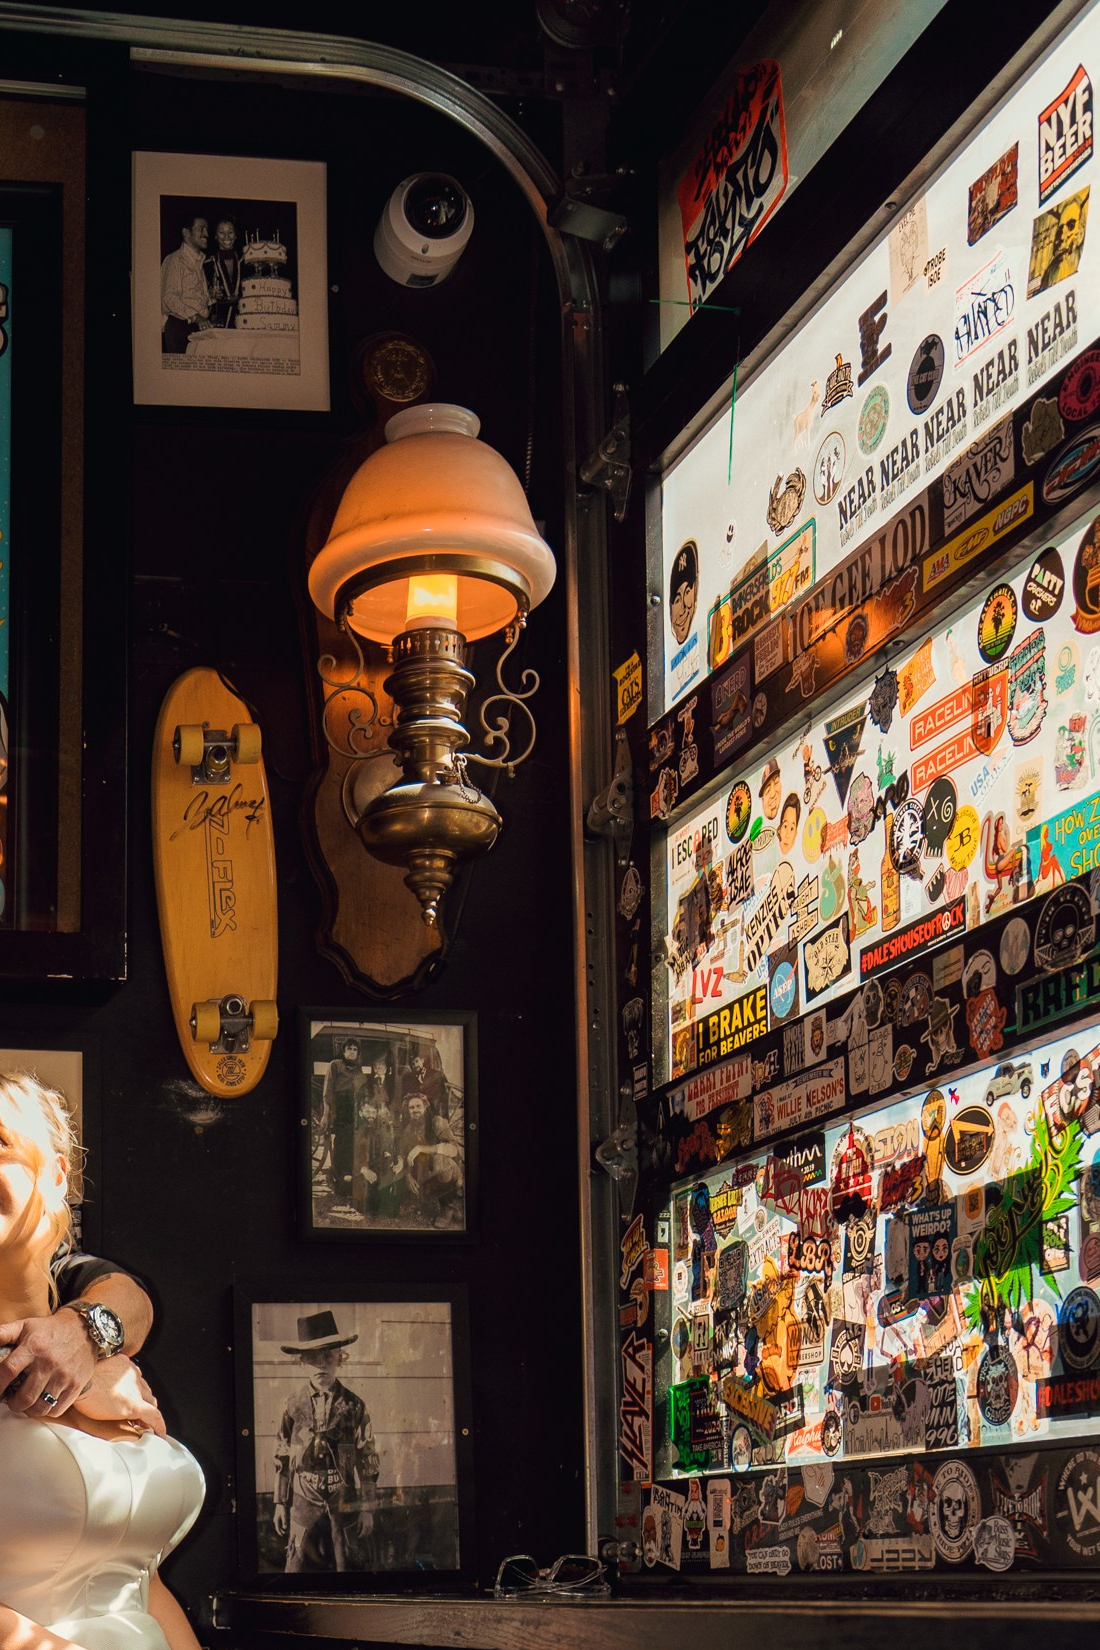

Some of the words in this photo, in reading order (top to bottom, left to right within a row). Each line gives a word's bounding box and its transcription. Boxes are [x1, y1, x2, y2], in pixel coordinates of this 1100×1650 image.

[1041, 111, 1092, 179] BEER
[1027, 289, 1078, 365] NEAR
[973, 338, 1019, 408] NEAR
[924, 387, 966, 455] NEAR
[880, 428, 920, 492] NEAR
[838, 465, 876, 530] NEAR
[1031, 563, 1063, 595] PARTY
[732, 590, 770, 642] ROCK
[692, 967, 724, 1004] LVZ
[709, 988, 766, 1044] BRAKE
[700, 1044, 718, 1066] FOR
[720, 1020, 767, 1056] BEAVERS
[777, 1096, 802, 1121] WILLIE
[806, 1078, 844, 1109] NELSON'S
[815, 1101, 833, 1115] PICNIC
[911, 1210, 940, 1224] WHAT'S
[941, 1208, 952, 1220] UP
[911, 1220, 951, 1238] WEIRDO?
